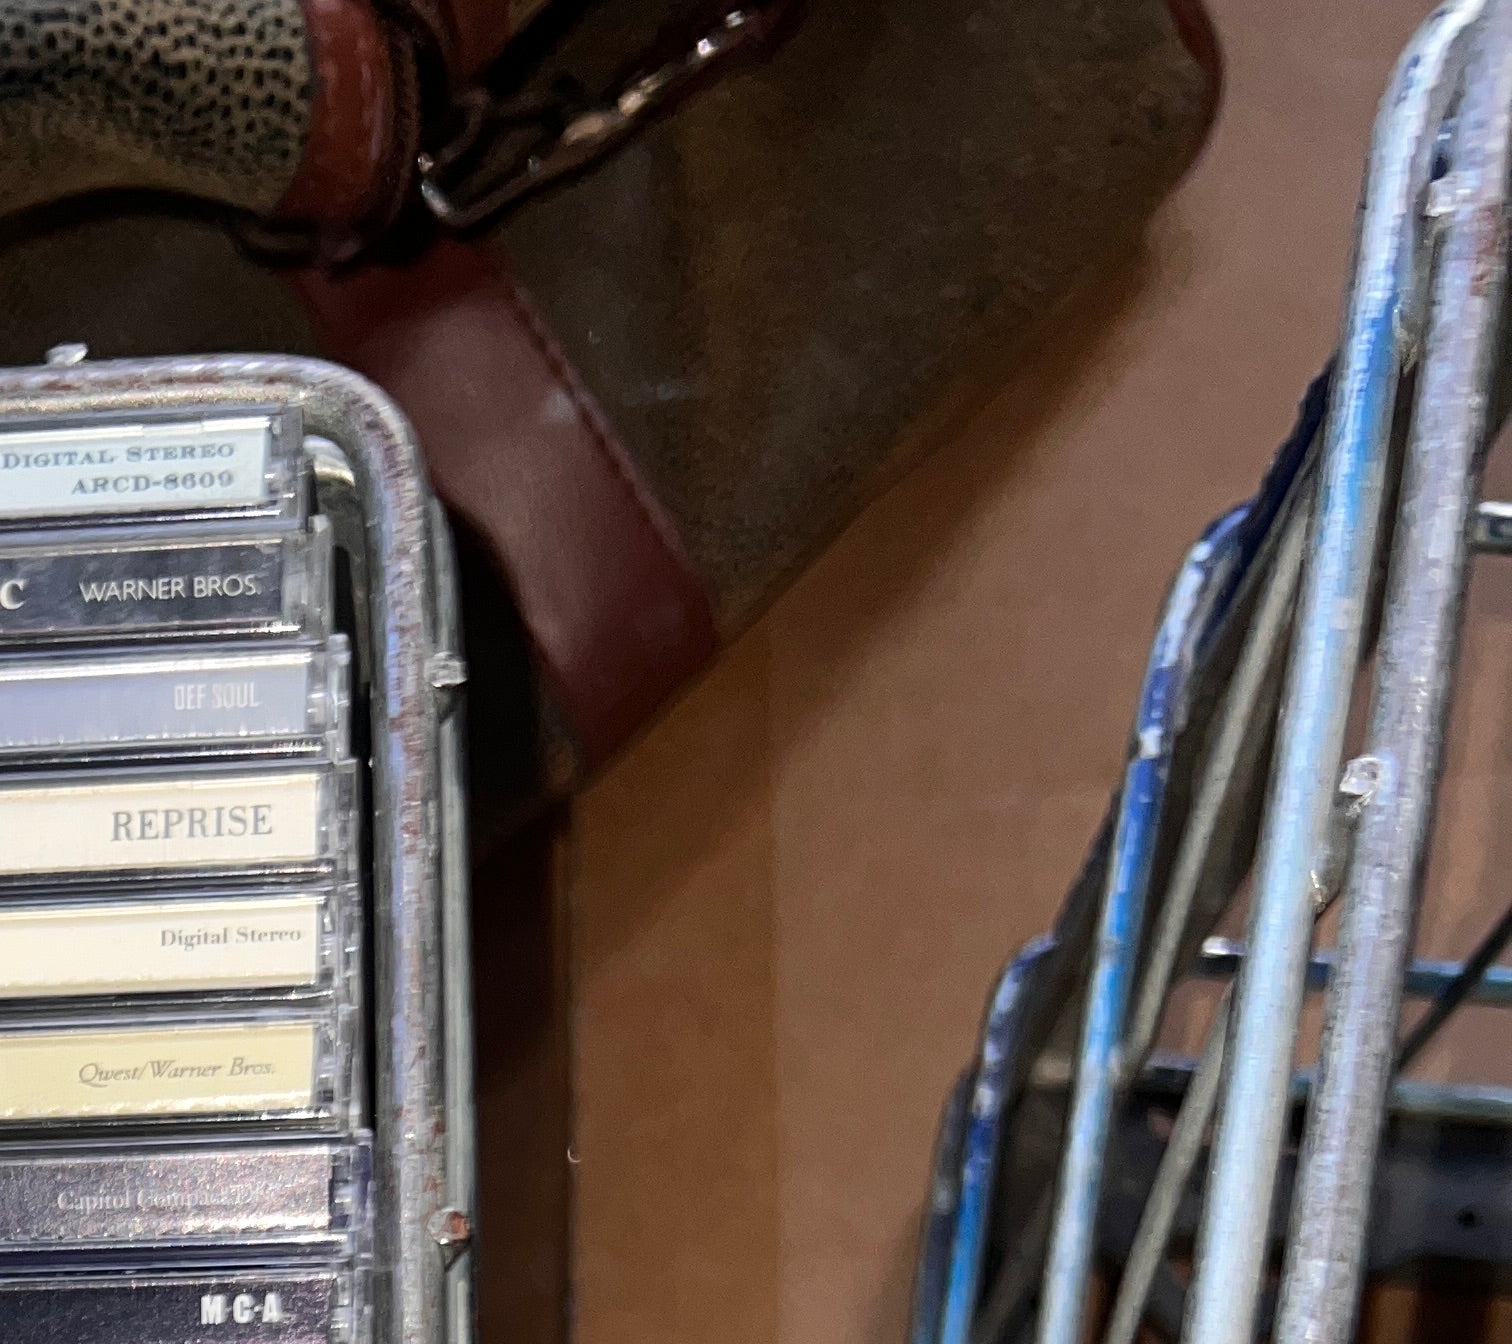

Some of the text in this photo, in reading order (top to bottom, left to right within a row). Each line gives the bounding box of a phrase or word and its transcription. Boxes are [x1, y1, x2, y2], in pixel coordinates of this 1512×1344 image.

[2, 443, 235, 471] DIGITAL STEREO
[72, 471, 233, 496] ARCD-8609
[80, 577, 185, 603] WARNER
[193, 574, 260, 599] BROS.
[174, 682, 259, 711] DEF SOUL
[111, 804, 274, 842] REPRISE
[160, 926, 302, 952] Digital Stereo
[79, 1058, 276, 1088] Qwest/Warner Bros.
